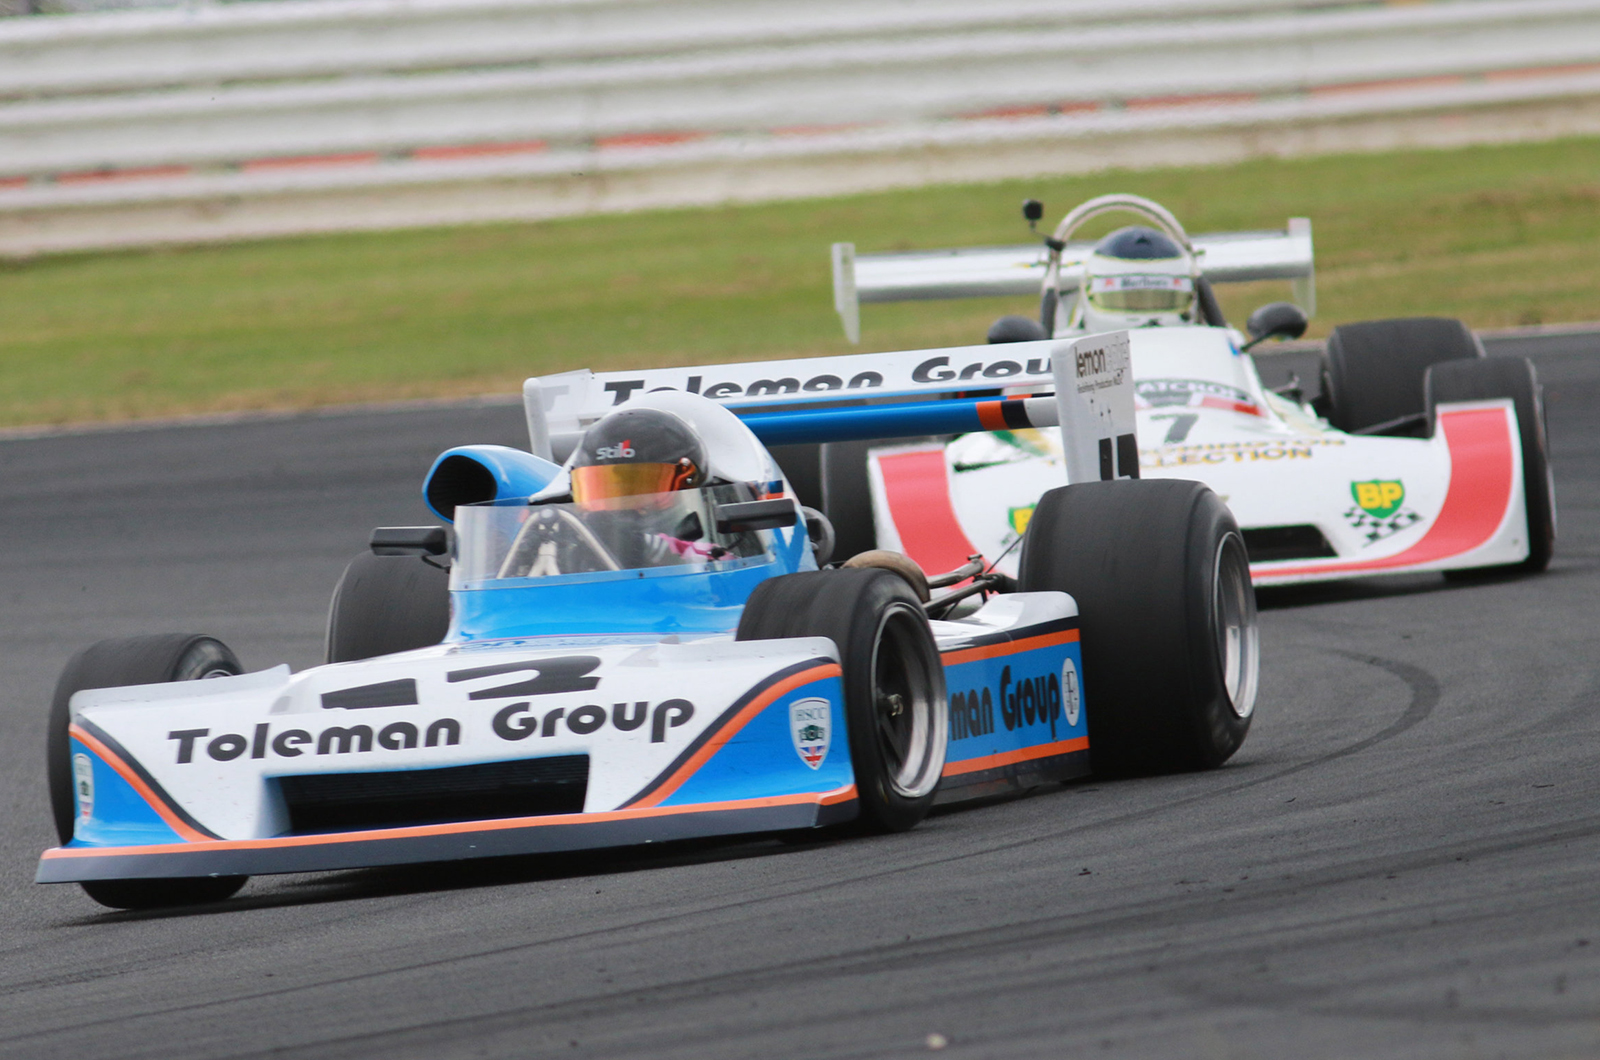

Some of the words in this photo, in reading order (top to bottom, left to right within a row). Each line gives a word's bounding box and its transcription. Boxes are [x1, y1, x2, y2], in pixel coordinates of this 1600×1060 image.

[604, 371, 883, 406] Tleman
[1149, 413, 1199, 444] 7
[1356, 482, 1402, 509] BP
[319, 655, 603, 711] 12
[949, 686, 995, 741] man
[1000, 664, 1061, 742] Group
[168, 717, 461, 765] Toleman
[492, 698, 695, 744] Group
